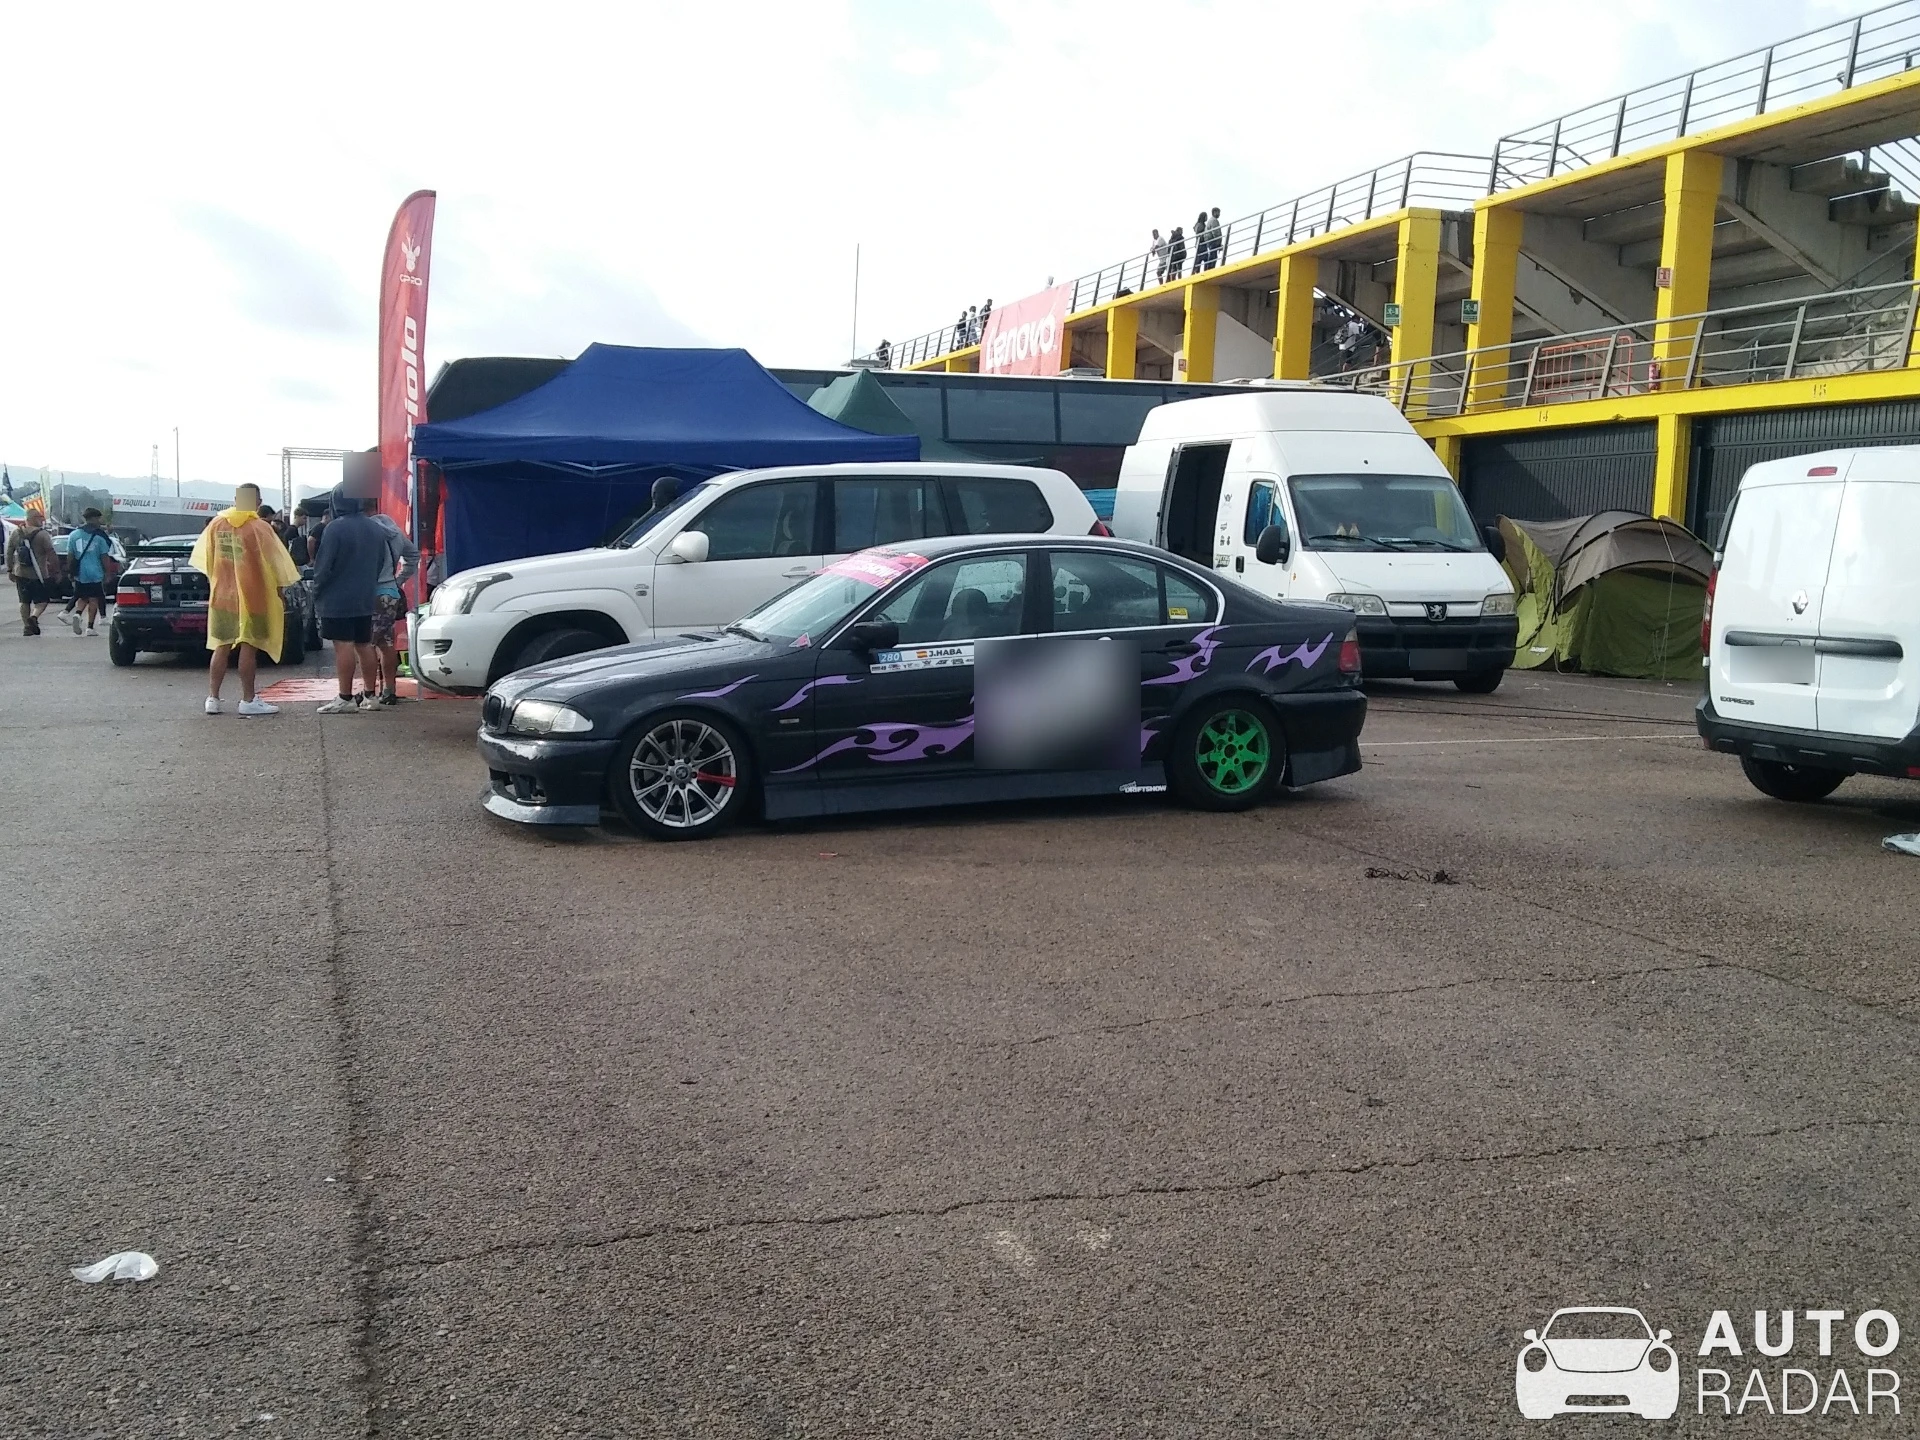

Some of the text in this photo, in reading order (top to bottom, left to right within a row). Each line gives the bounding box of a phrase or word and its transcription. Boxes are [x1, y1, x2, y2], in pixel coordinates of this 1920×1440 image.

[985, 313, 1056, 371] Lenovo
[122, 499, 151, 508] TAQUILLA
[880, 652, 900, 663] 280
[929, 648, 962, 658] J.HABA
[1720, 696, 1755, 705] EXPRESS
